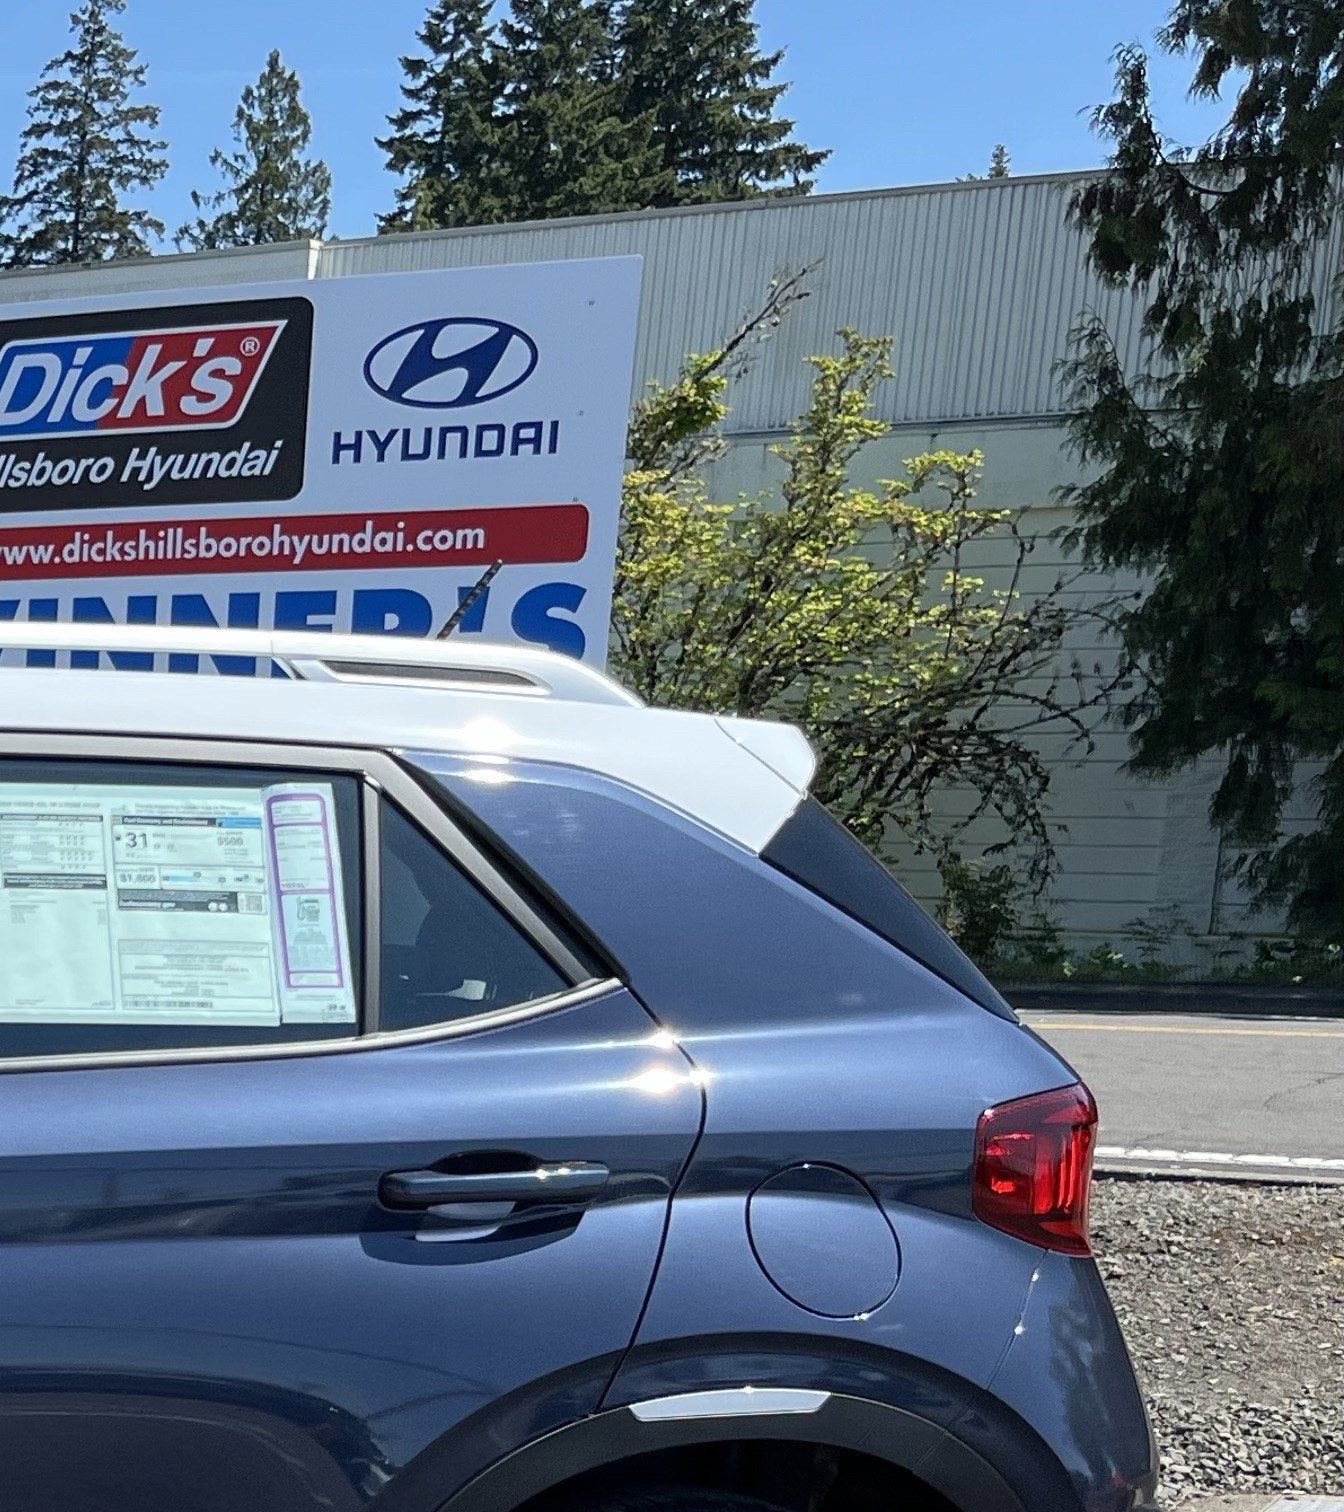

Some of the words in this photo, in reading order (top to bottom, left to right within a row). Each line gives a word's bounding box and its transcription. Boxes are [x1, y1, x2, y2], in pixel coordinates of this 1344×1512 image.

[120, 439, 284, 491] Hyundai
[331, 419, 560, 465] HYUNDAI
[124, 832, 148, 848] 31
